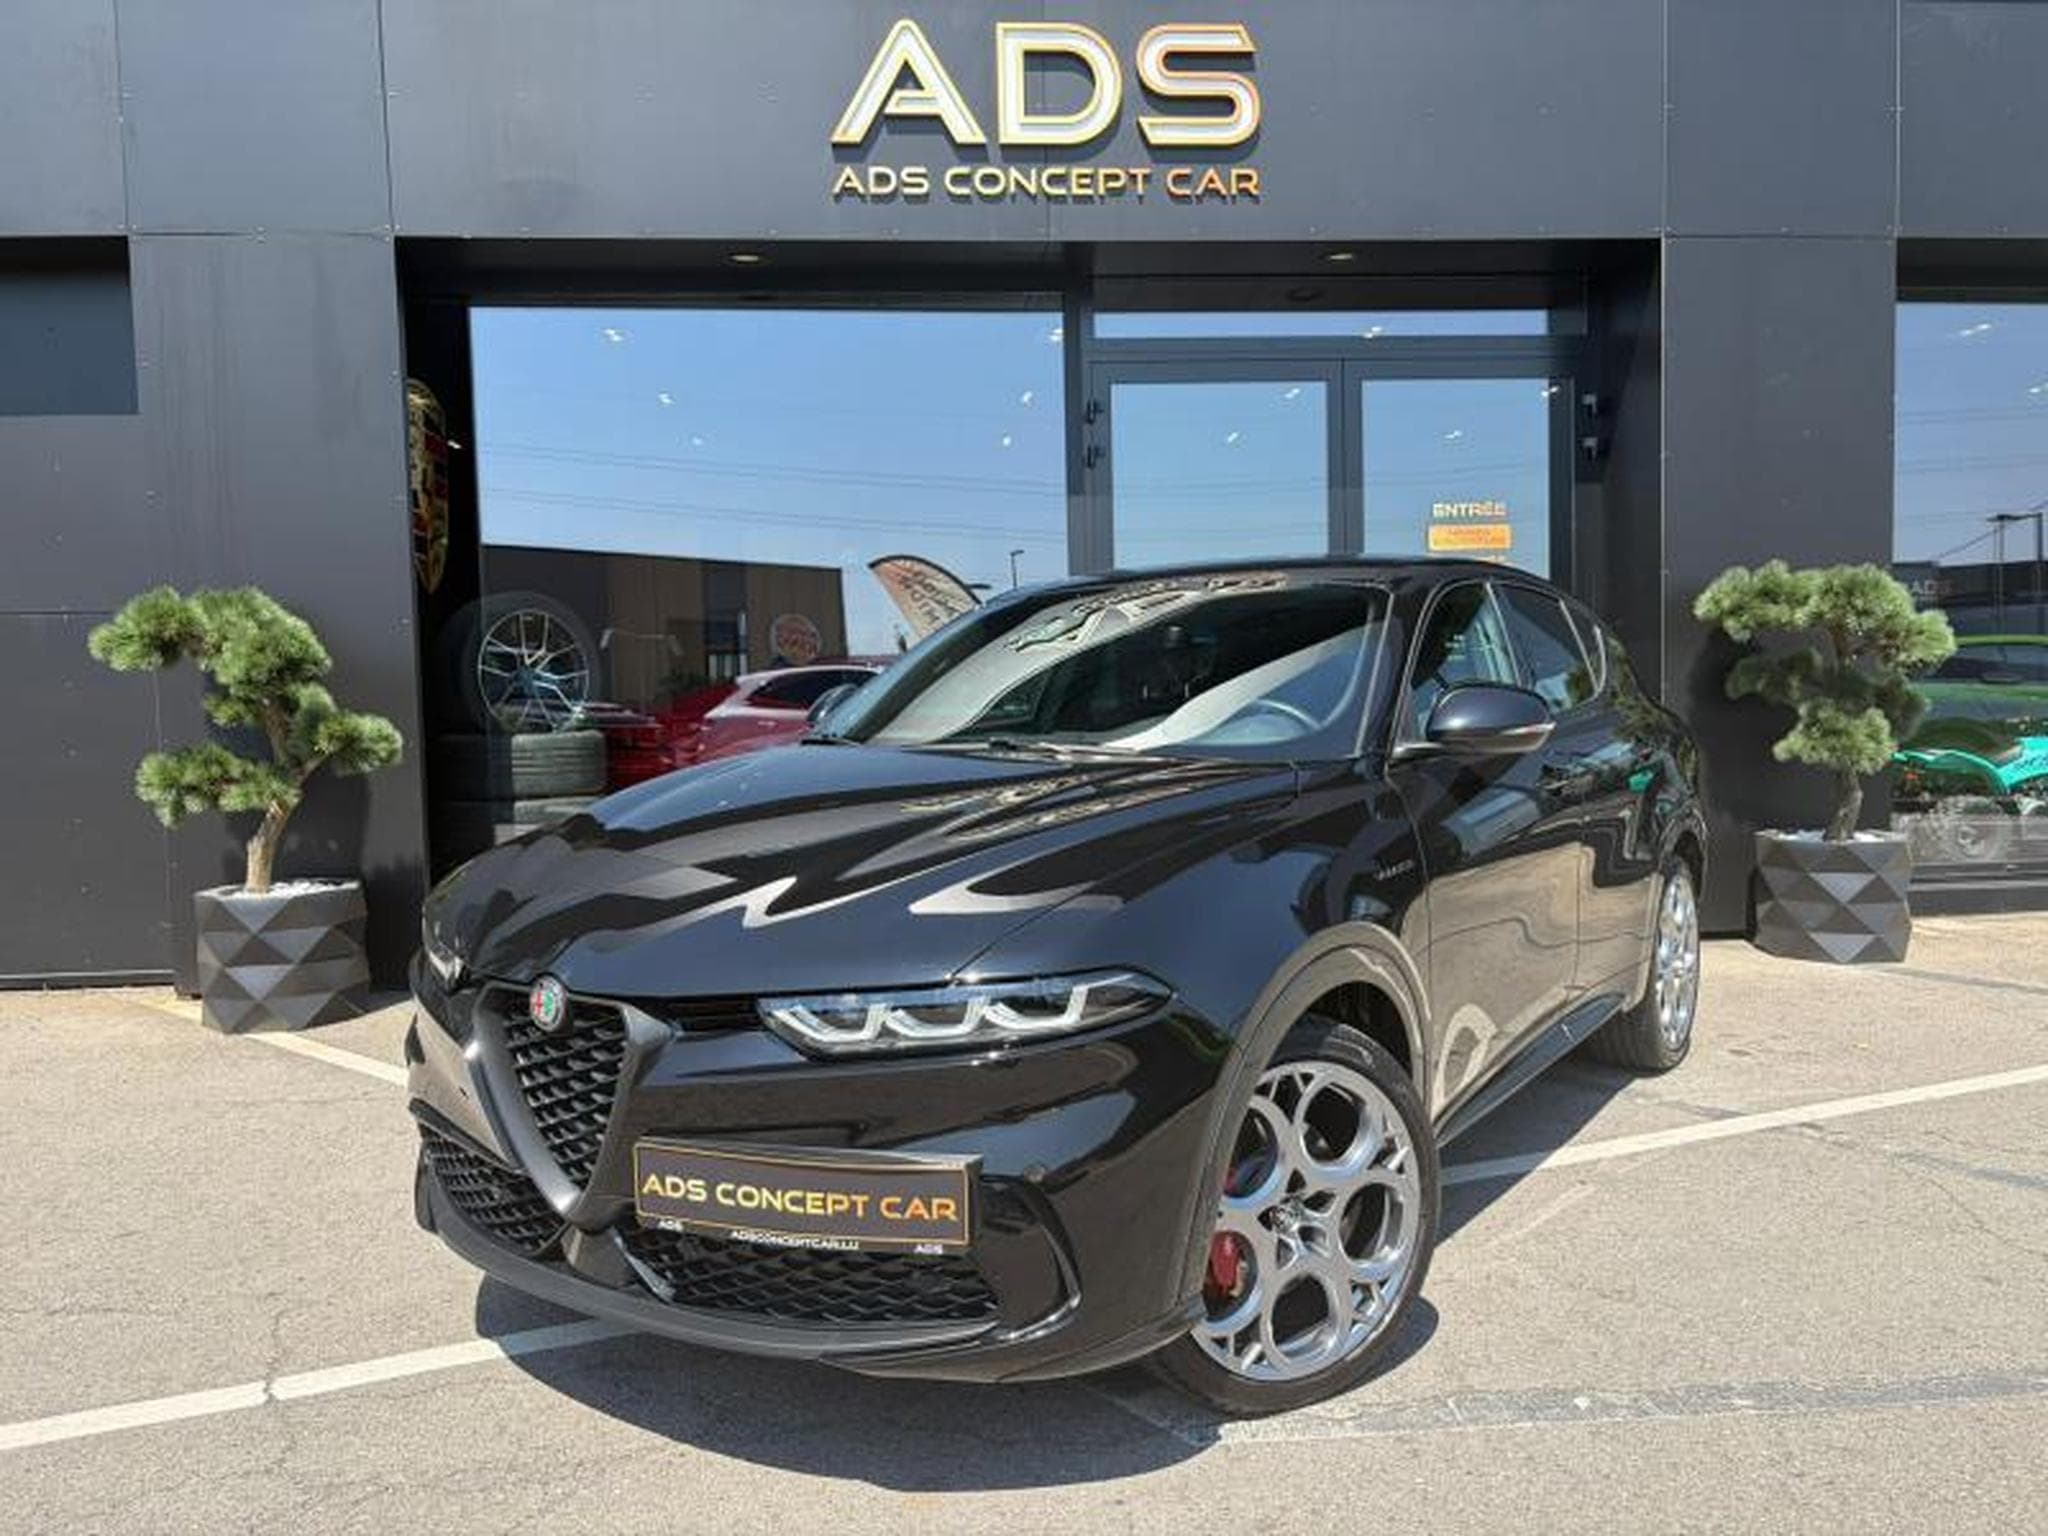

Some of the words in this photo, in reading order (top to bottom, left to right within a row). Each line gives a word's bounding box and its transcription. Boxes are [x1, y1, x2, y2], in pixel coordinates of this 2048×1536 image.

[830, 19, 1261, 145] ADS
[832, 166, 929, 196] ADS
[944, 167, 1151, 196] CONCEPT
[1166, 168, 1260, 196] CAR
[641, 1173, 708, 1202] ADS
[715, 1182, 870, 1218] CONCEPT
[880, 1196, 958, 1221] CAR
